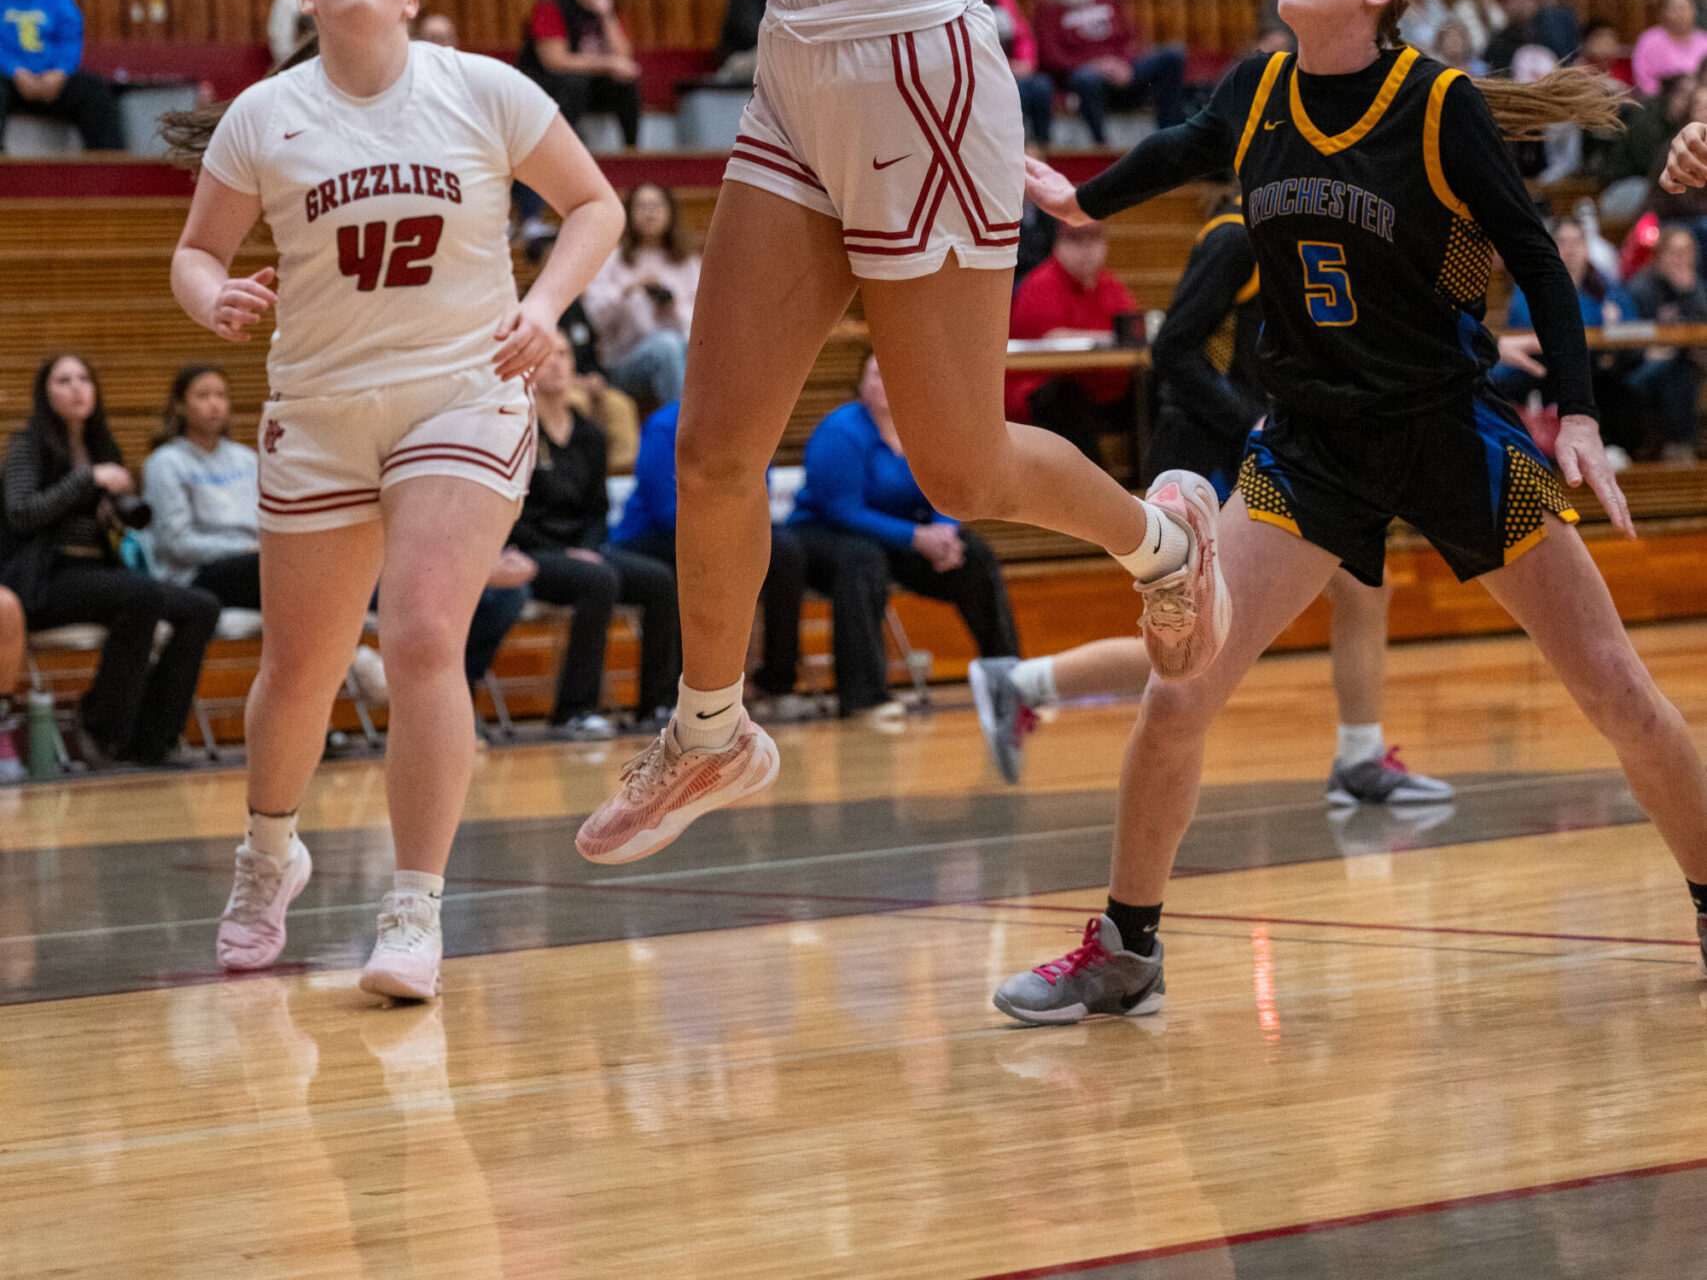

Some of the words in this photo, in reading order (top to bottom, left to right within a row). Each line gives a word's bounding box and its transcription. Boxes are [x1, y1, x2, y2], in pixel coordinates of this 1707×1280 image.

[305, 163, 463, 223] GRIZZLIES
[1249, 177, 1396, 243] ROCHESTER
[336, 214, 444, 292] 42
[1297, 239, 1359, 327] 5
